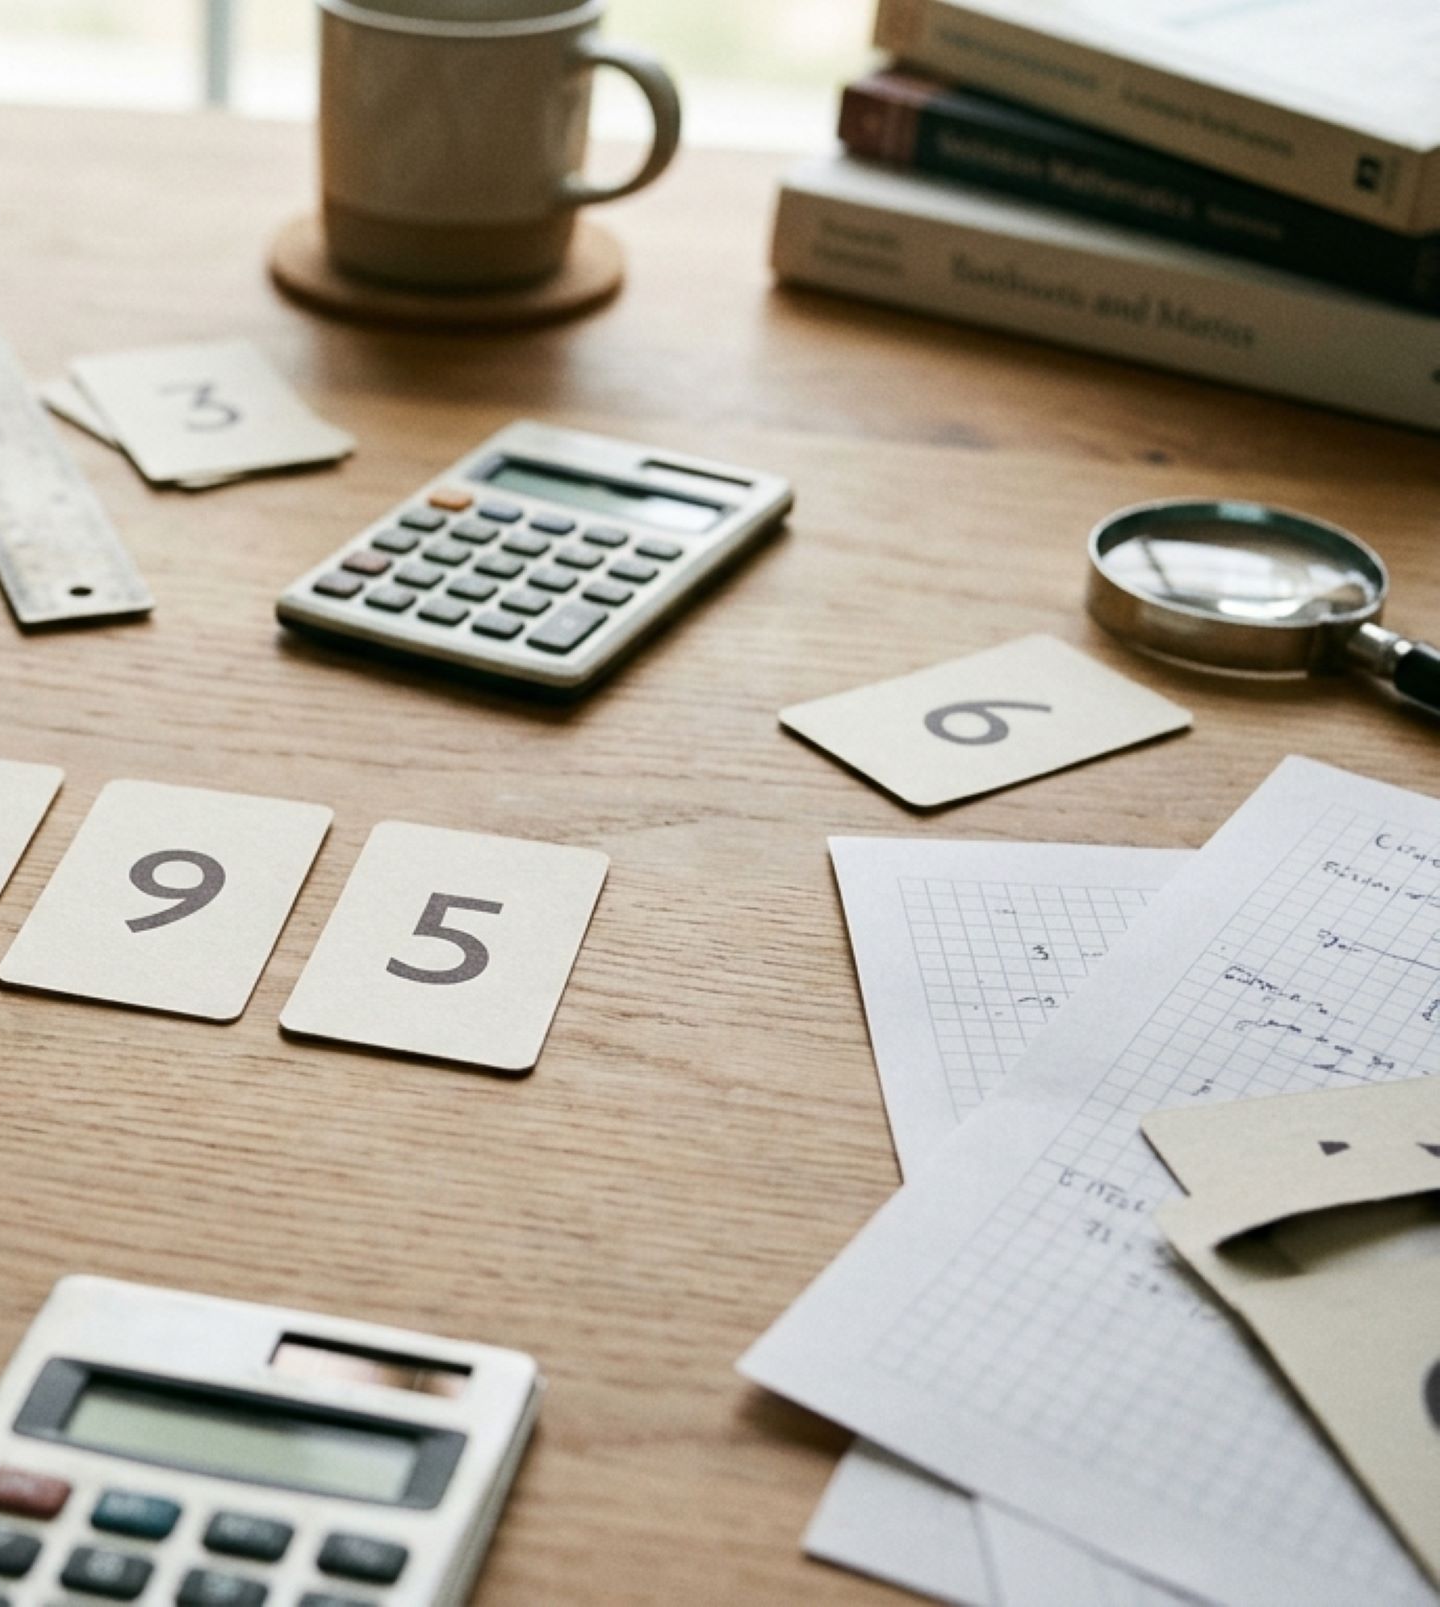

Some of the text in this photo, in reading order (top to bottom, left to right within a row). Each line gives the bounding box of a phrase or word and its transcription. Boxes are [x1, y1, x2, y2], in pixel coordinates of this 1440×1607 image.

[158, 378, 242, 434] 3
[923, 699, 1053, 746] 6
[124, 848, 226, 933] 9
[386, 891, 504, 985] 5
